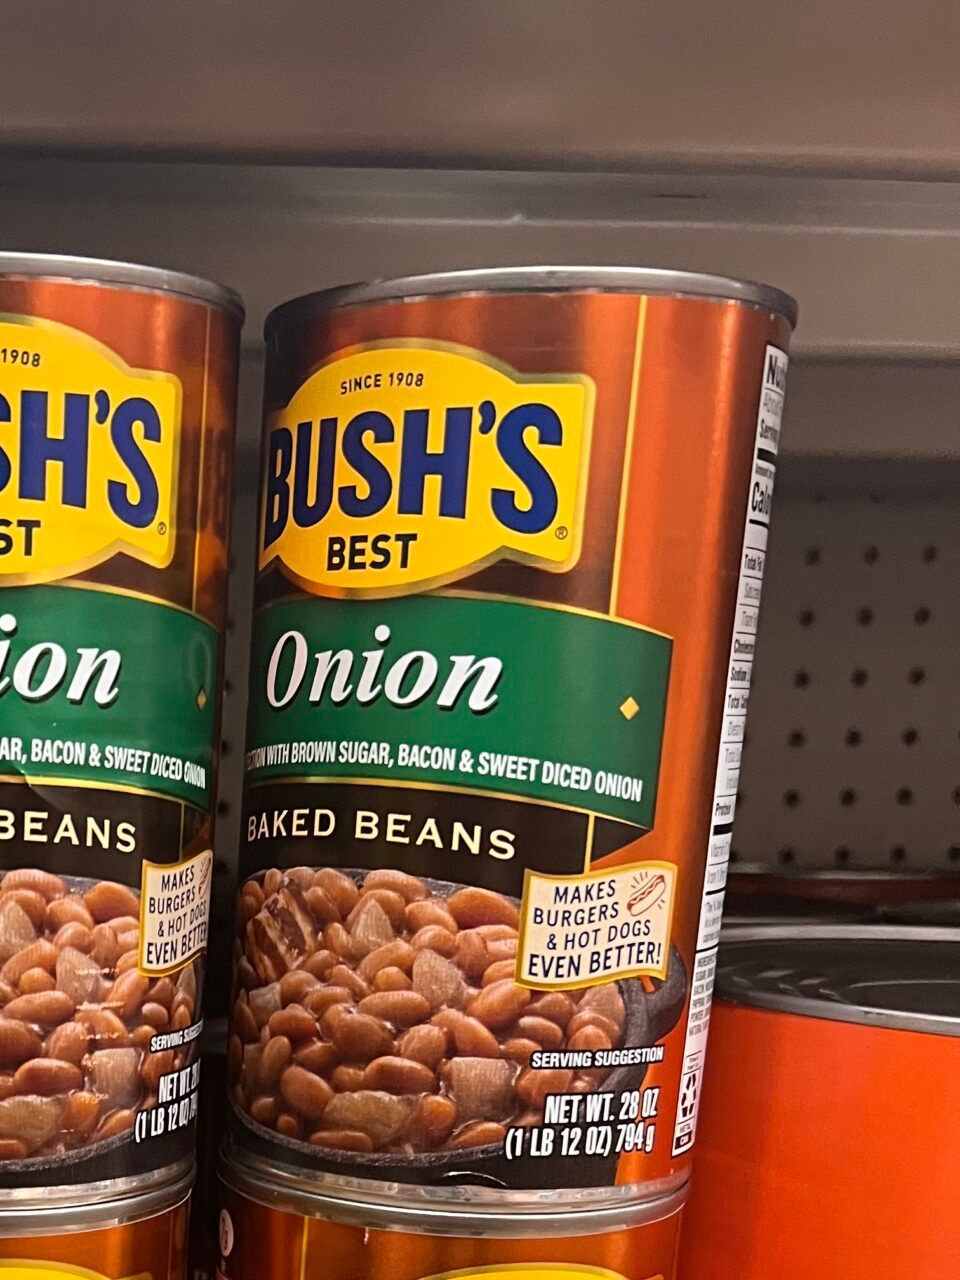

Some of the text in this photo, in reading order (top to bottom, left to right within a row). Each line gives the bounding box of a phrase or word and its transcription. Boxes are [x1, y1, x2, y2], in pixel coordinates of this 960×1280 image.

[1, 348, 40, 367] 1908
[340, 372, 424, 394] SINCE 1908
[265, 401, 563, 550] BUSH'S
[327, 533, 417, 571] BEST
[266, 624, 502, 711] Onion
[247, 809, 516, 860] BAKED BEANS
[553, 879, 616, 905] MAKES
[533, 901, 619, 926] BURGERS
[547, 919, 651, 950] & HOT DOGS
[529, 942, 661, 978] EVEN BETTER!
[532, 1050, 591, 1068] SERVING
[594, 1047, 664, 1066] SUGGESTION
[544, 1089, 659, 1123] NET WT. 28 OZ
[505, 1125, 613, 1160] (1 LB 12 OZ)
